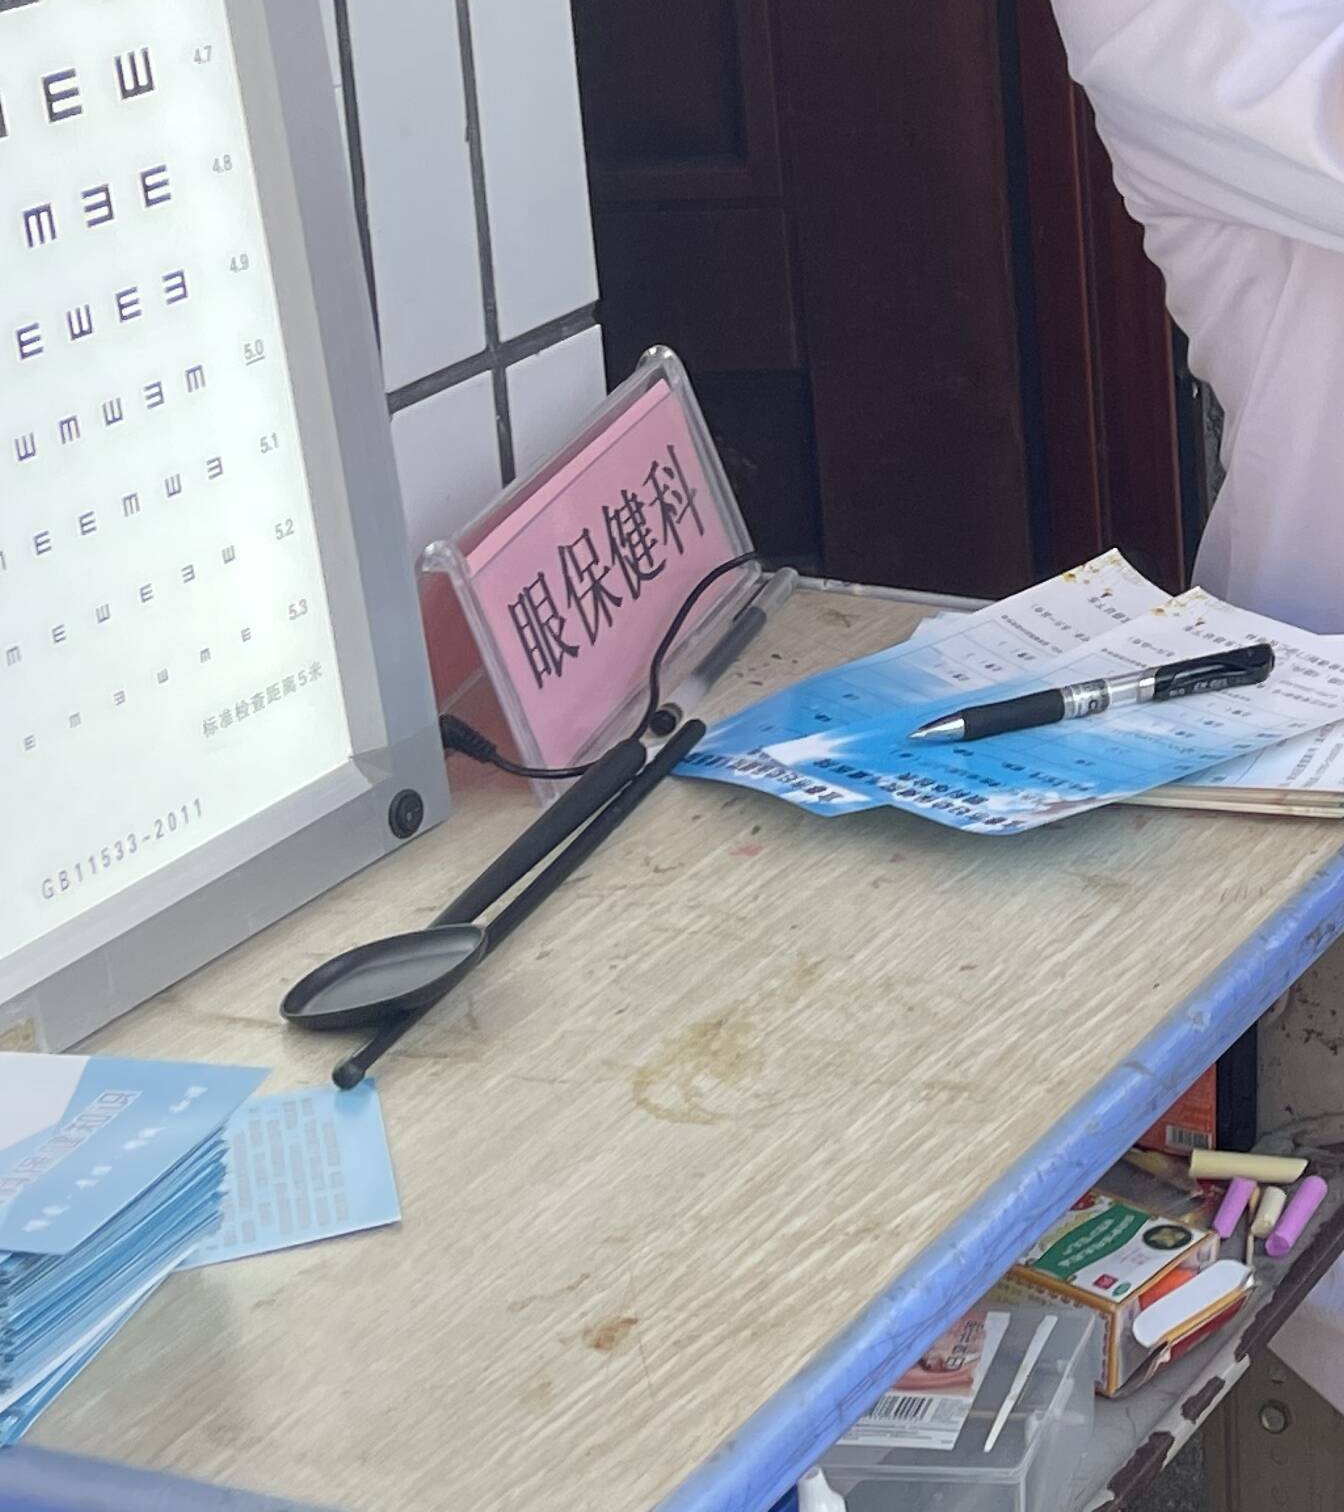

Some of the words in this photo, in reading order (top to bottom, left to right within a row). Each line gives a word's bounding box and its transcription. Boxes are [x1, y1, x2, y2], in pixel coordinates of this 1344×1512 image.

[193, 44, 213, 65] 4.7
[212, 153, 233, 175] 4.8
[229, 253, 250, 275] 4.9
[243, 338, 265, 364] 5.0
[259, 431, 279, 455] 5.1
[274, 517, 295, 541] 5.2
[508, 444, 705, 689] 眼保健科
[288, 598, 309, 621] 5.3
[202, 660, 324, 739] 标准检查距离5米
[41, 797, 205, 902] GB11533-2011
